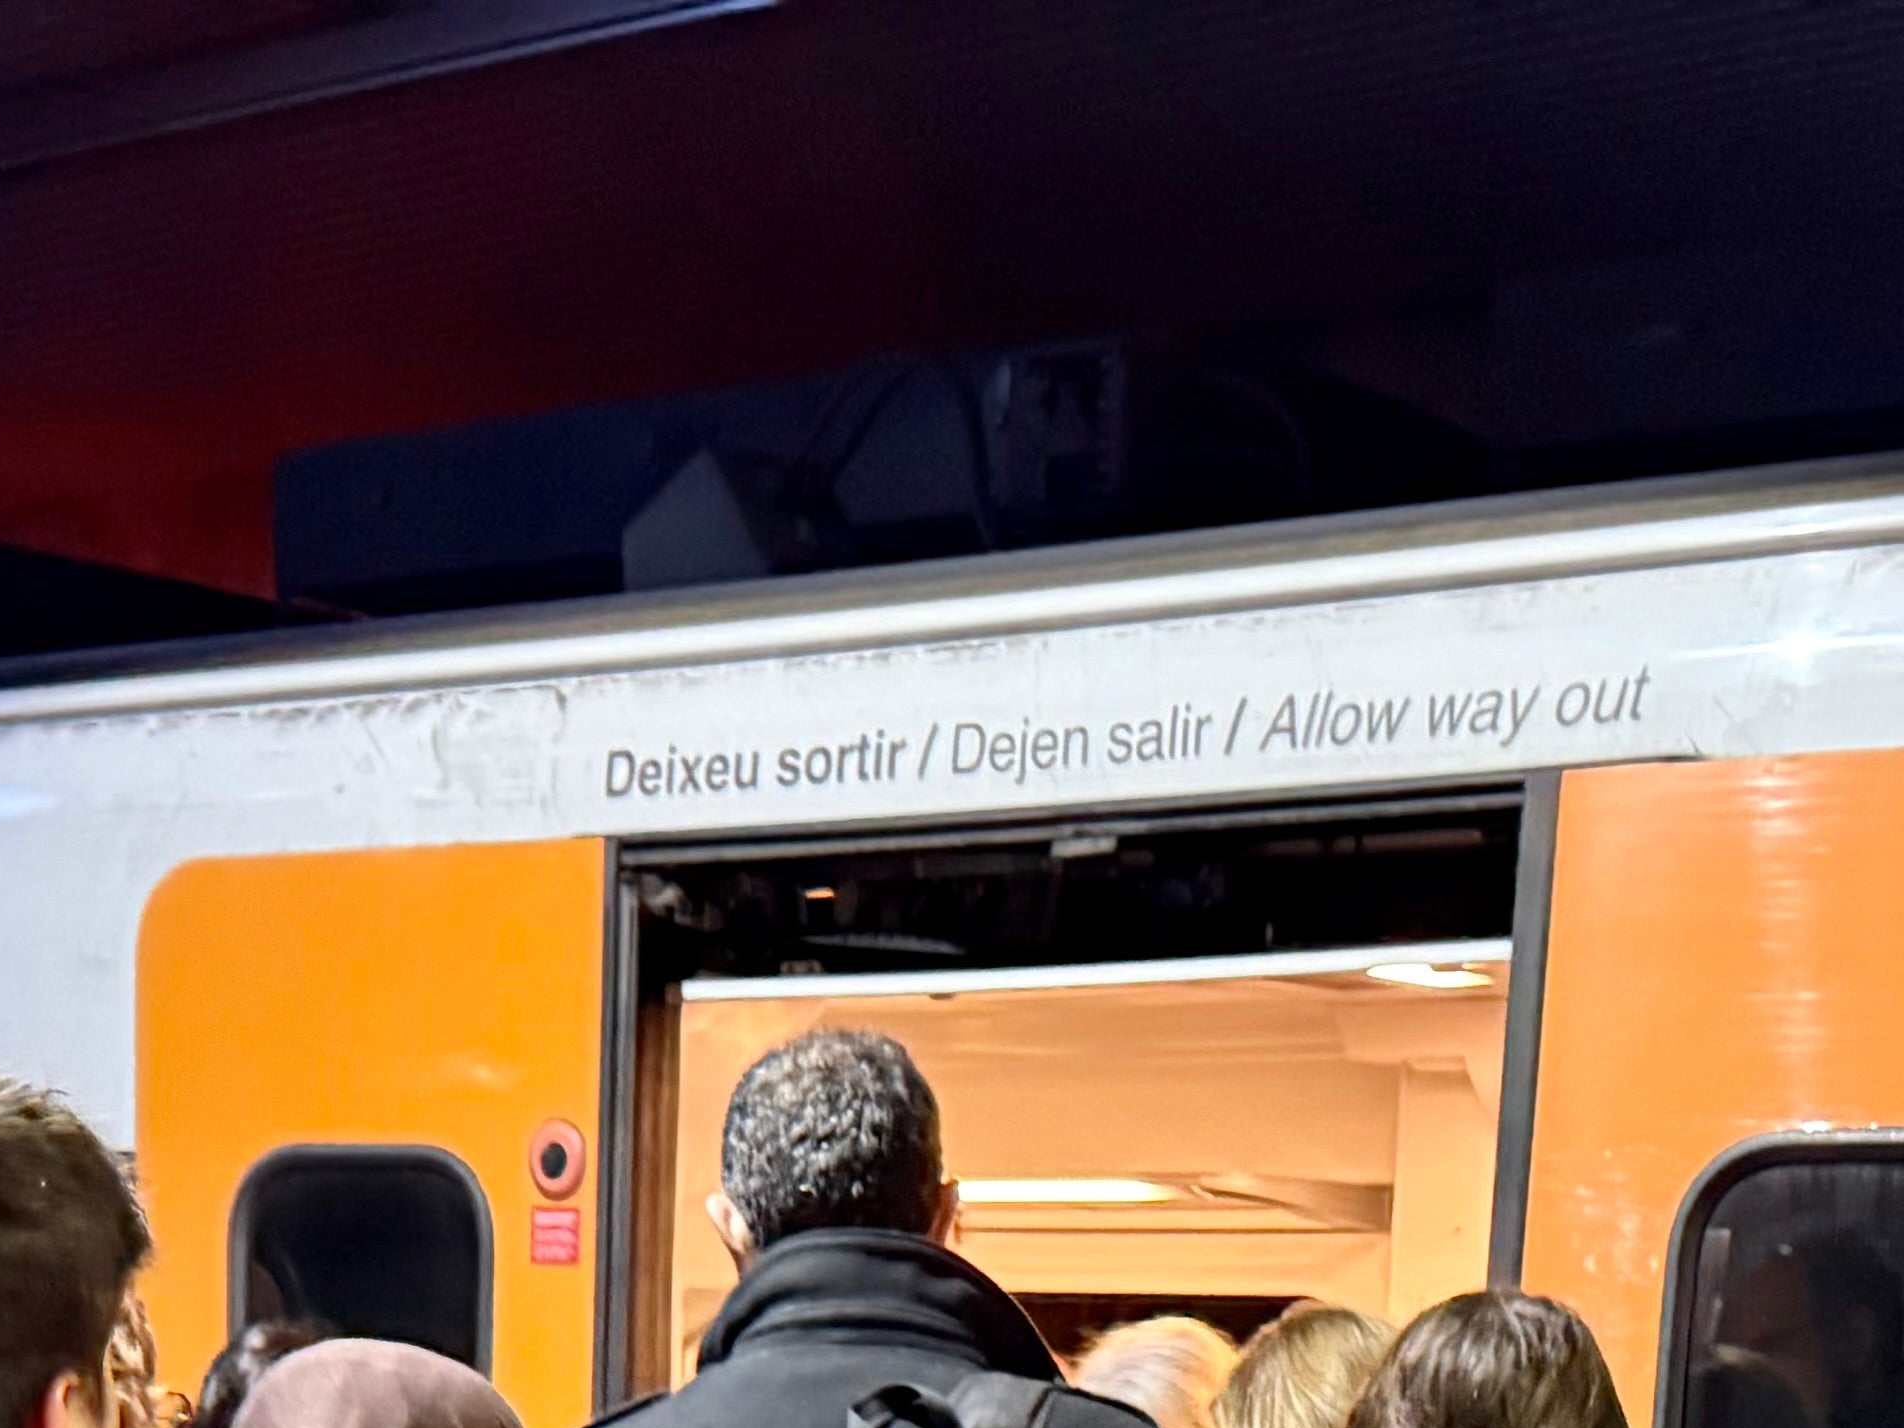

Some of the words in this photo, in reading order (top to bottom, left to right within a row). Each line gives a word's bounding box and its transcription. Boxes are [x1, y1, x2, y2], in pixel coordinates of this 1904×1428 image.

[604, 744, 760, 799] Deixeu
[775, 729, 908, 788] sortir
[917, 721, 941, 781] /
[951, 716, 1090, 786] Dejen
[1107, 703, 1213, 766] salir
[1223, 695, 1249, 756] /
[1259, 688, 1412, 754] Allow
[1426, 684, 1542, 748] way
[1554, 664, 1652, 728] out
